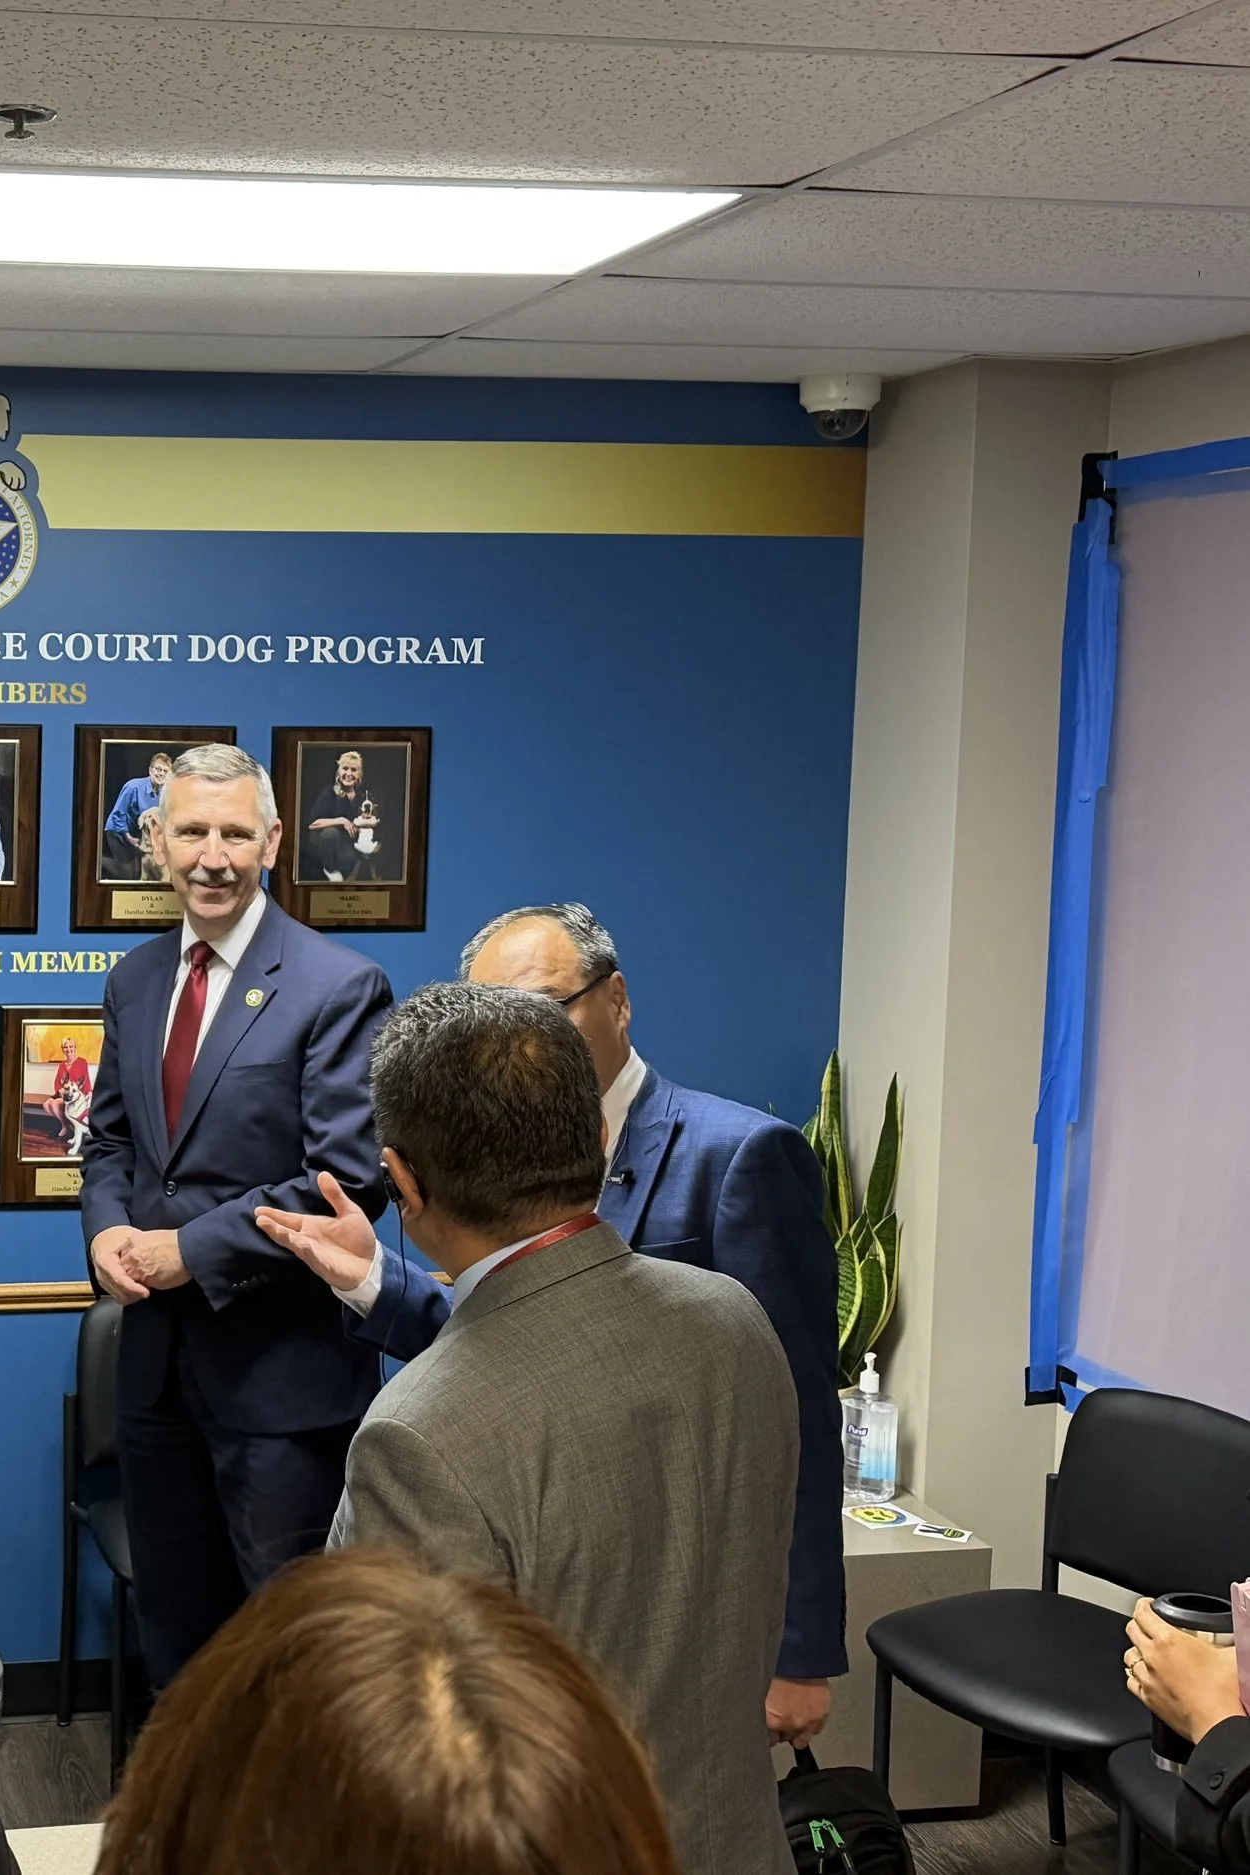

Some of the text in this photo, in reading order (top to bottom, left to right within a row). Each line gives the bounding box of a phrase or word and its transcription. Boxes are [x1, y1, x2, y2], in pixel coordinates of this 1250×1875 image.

[8, 494, 34, 574] ATTORNEY
[38, 632, 177, 662] COURT
[188, 634, 275, 664] DOG
[285, 635, 485, 665] PROGRAM
